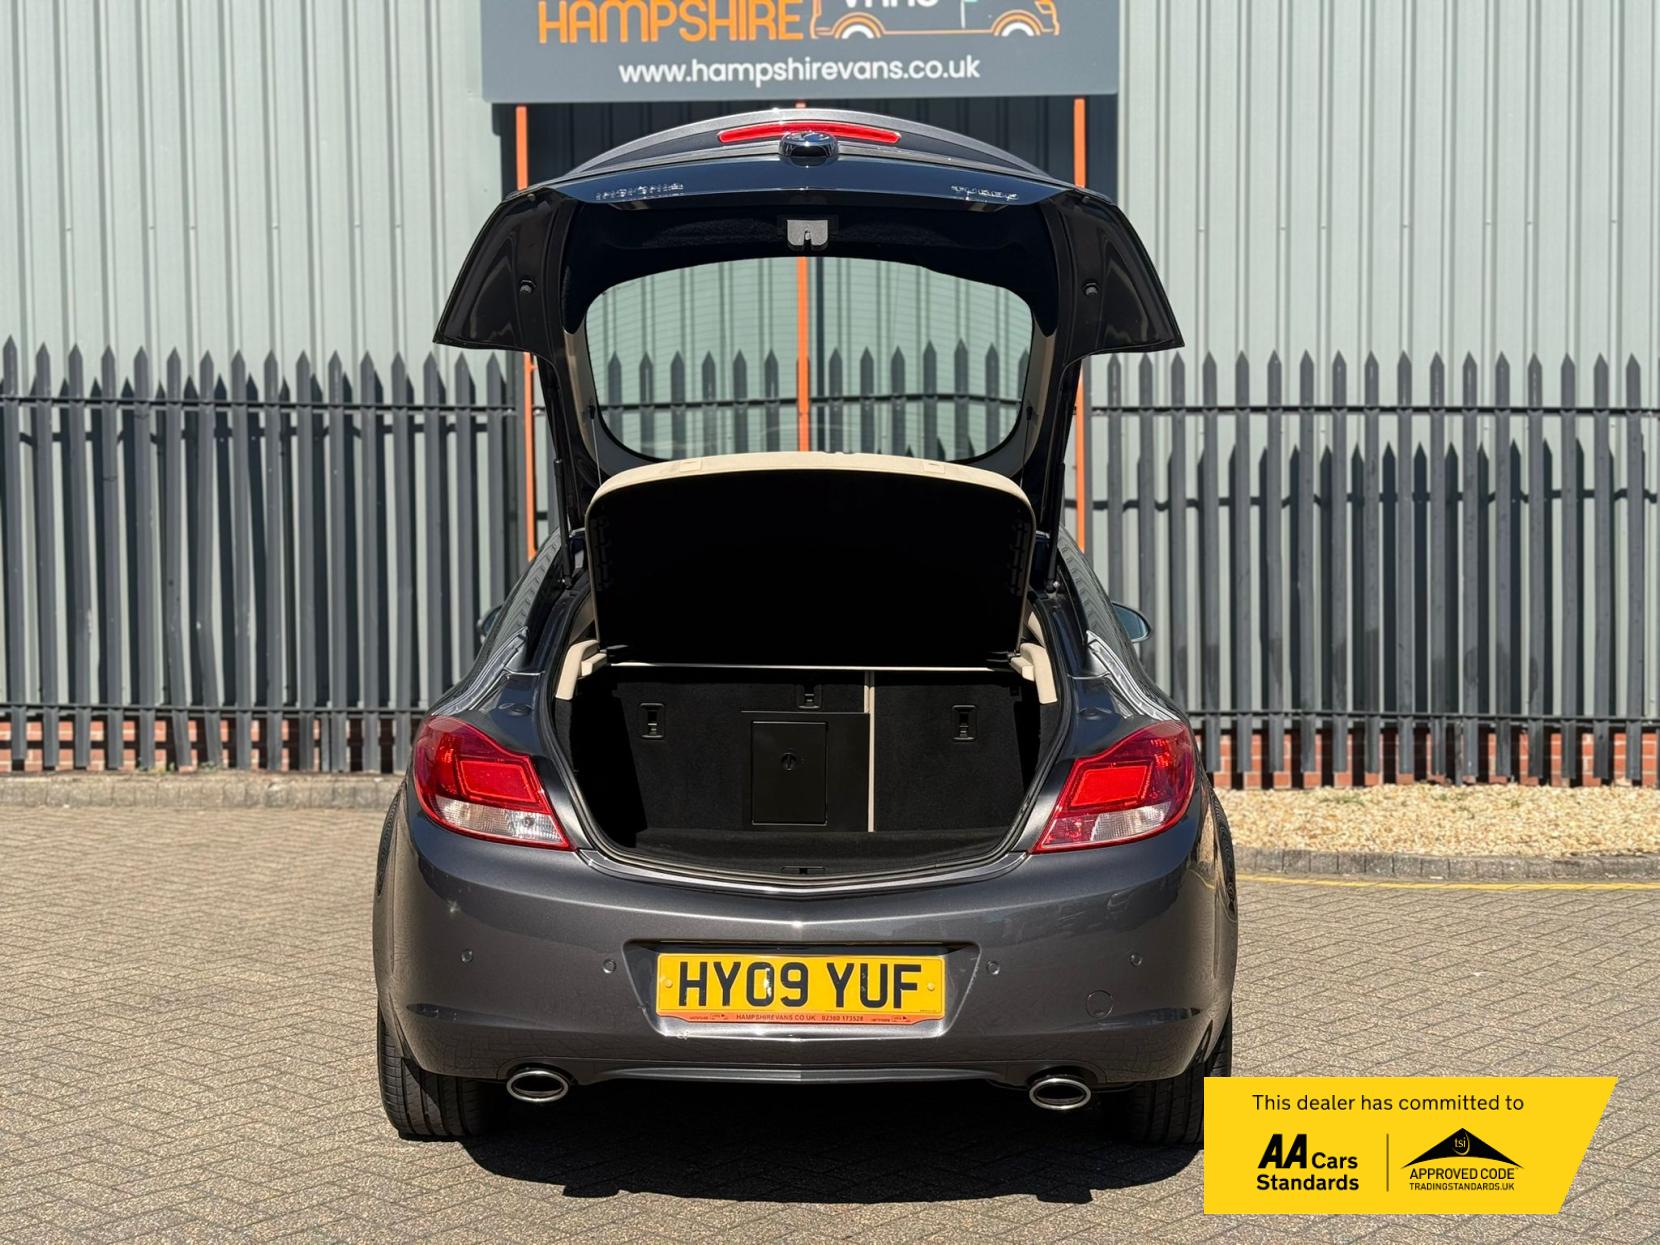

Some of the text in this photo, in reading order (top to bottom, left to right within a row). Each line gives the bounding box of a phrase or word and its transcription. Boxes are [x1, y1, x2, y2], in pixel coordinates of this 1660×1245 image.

[539, 0, 804, 43] HAMPSHIRE
[618, 54, 980, 87] www.hampshirevans.co.uk
[678, 961, 922, 1009] HY09 YUF
